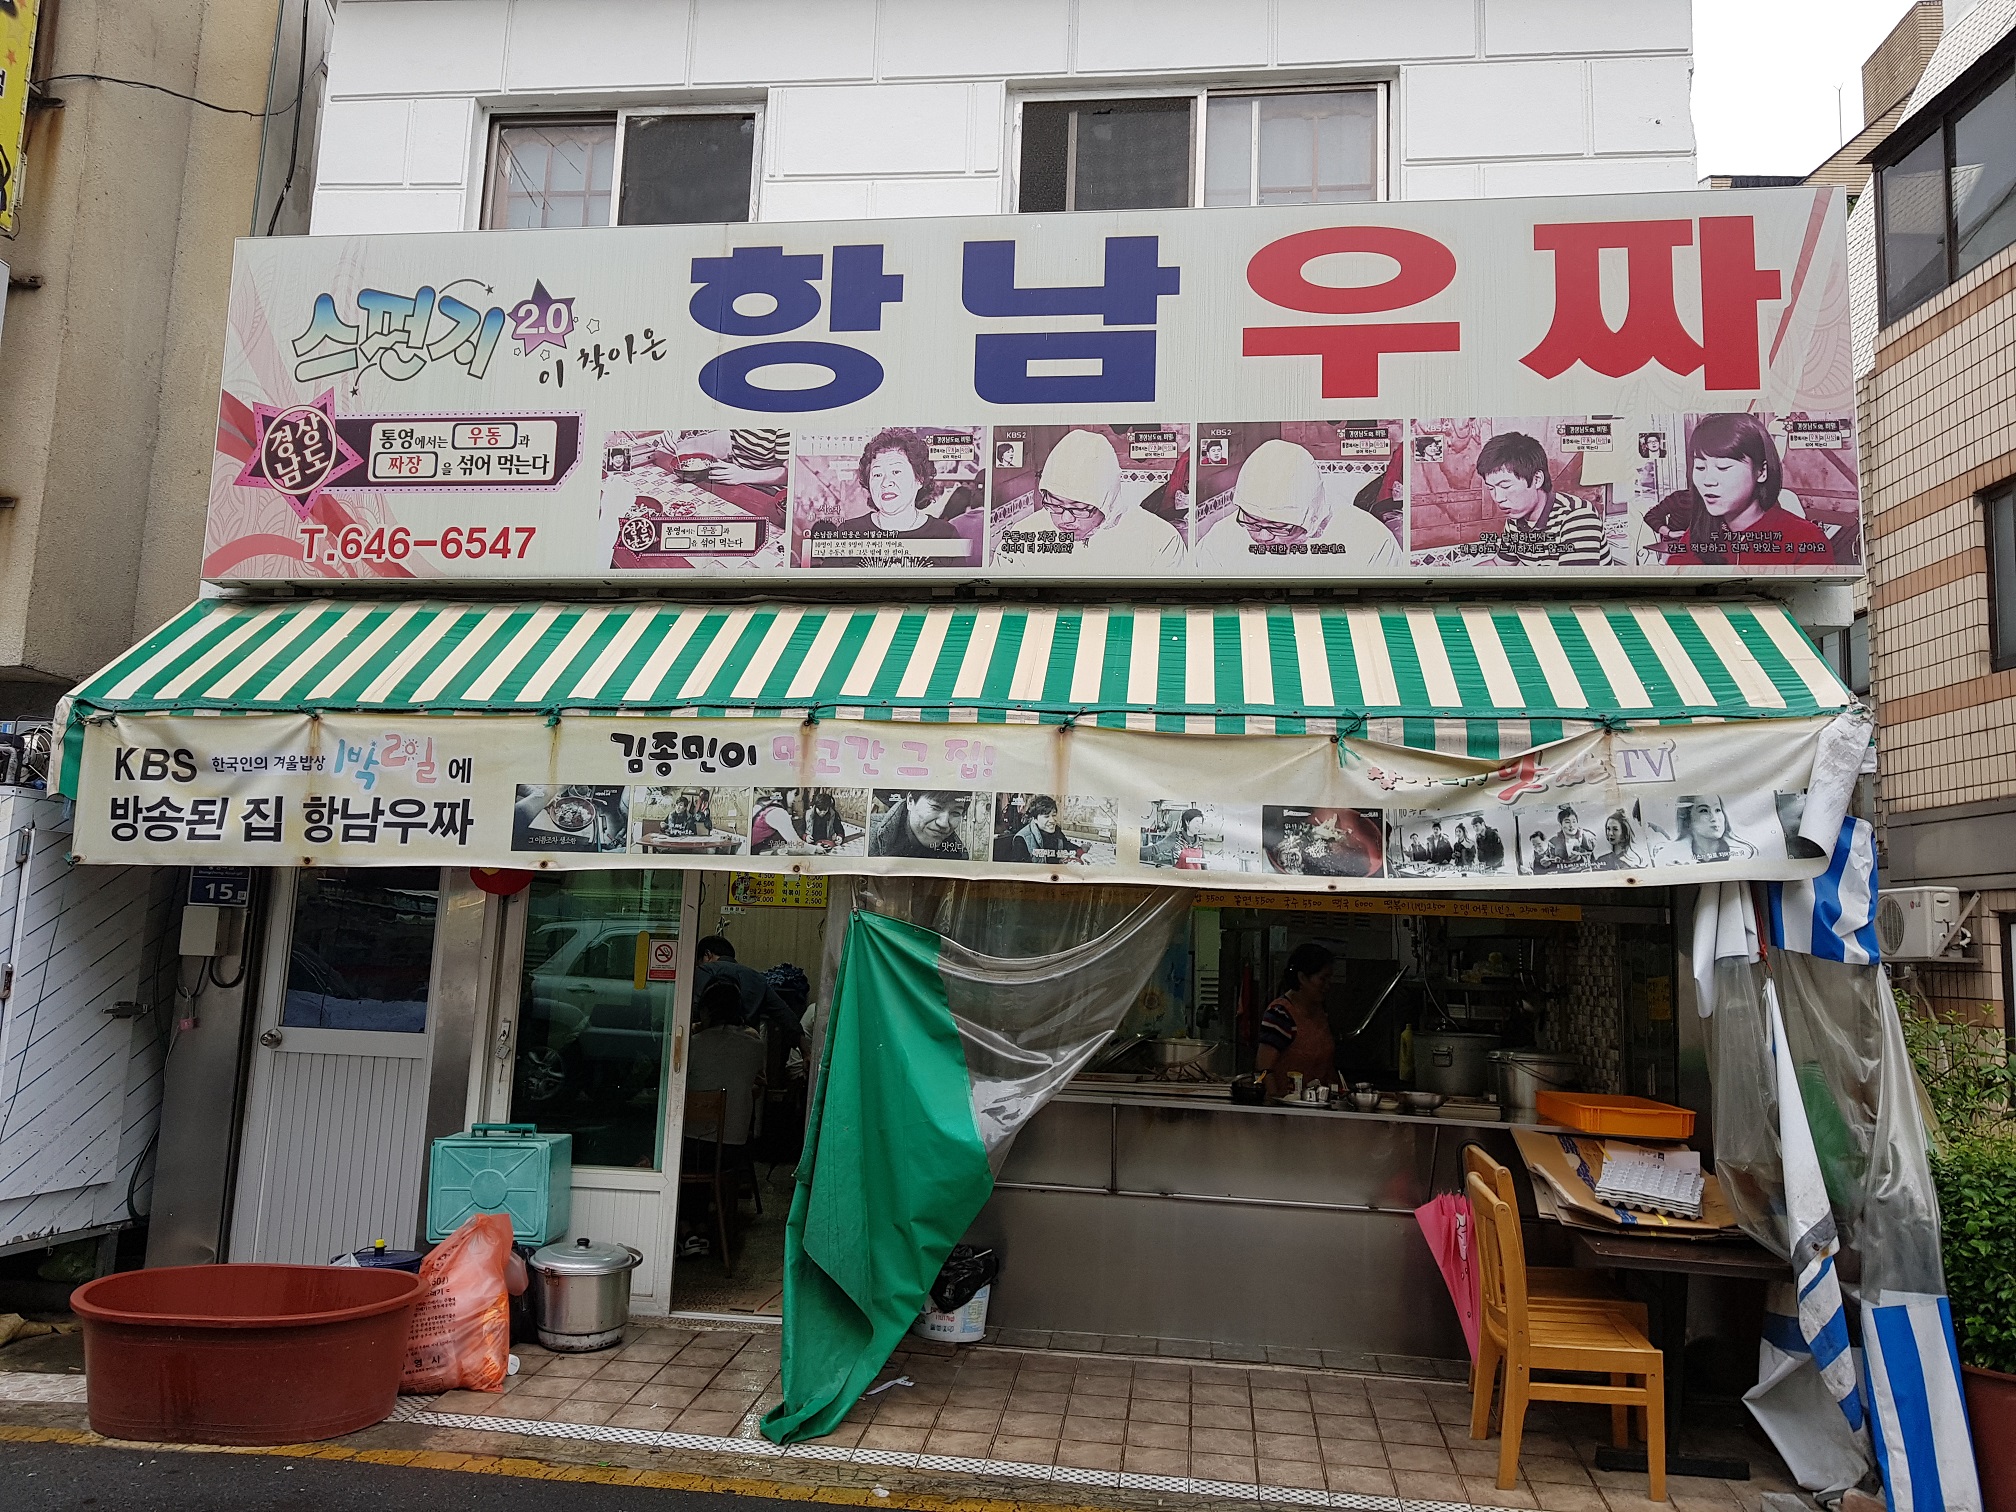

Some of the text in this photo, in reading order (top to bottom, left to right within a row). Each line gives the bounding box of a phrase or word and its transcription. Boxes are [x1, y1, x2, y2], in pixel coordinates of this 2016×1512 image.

[515, 302, 570, 335] 2.0
[538, 326, 669, 388] 이 찾아온
[378, 427, 449, 450] 통영에서는
[1006, 431, 1027, 439] KBS2
[1210, 428, 1232, 436] KBS2
[456, 454, 492, 477] 섞어
[496, 454, 551, 475] 먹는다
[299, 525, 537, 561] T.646-6547
[1668, 543, 1826, 554] 간도 적당하고 진짜 맛있는 것 같아요
[1710, 532, 1783, 542] 두 개가 만나니까
[113, 746, 199, 783] KBS
[610, 731, 758, 778] 김종민이
[1617, 747, 1669, 779] TV
[211, 755, 269, 773] 한국인의
[273, 754, 326, 773] 겨울밥상
[447, 757, 473, 784] 에
[109, 795, 475, 846] 방송된 집 항남우짜
[204, 882, 235, 900] 15
[1354, 899, 1374, 908] 6000
